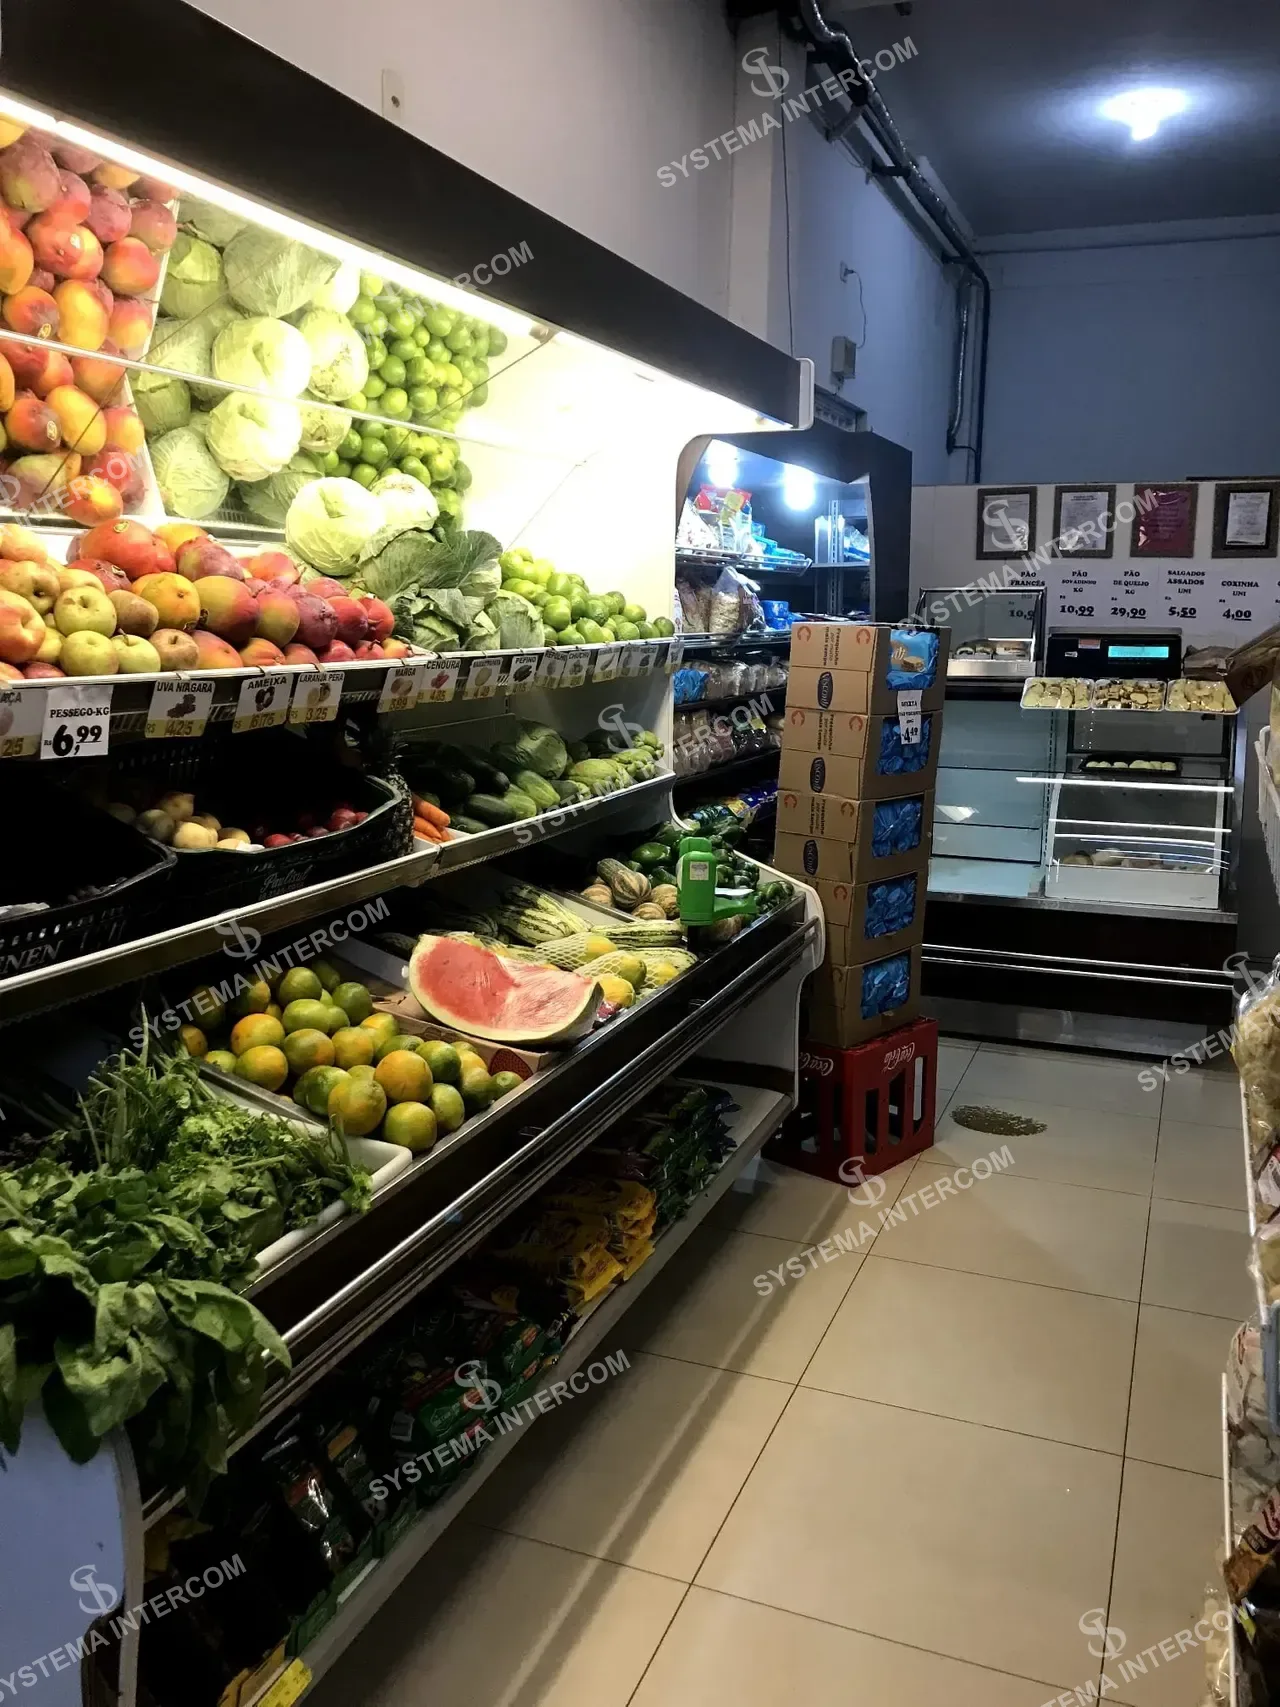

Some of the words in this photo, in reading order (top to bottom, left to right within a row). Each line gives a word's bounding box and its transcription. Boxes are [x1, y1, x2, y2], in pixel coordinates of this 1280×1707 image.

[1020, 570, 1037, 578] PÃO
[1072, 570, 1088, 578] PÃO
[1124, 570, 1140, 578] PÃO
[1167, 570, 1206, 578] SALGADOS
[1166, 578, 1205, 586] ASSADOS
[1221, 580, 1260, 588] COXINHA
[1009, 609, 1036, 621] 10,9
[1060, 605, 1095, 617] 10,99
[1110, 607, 1147, 619] 29,90
[1168, 606, 1197, 618] 5,50
[1222, 608, 1252, 622] 4,00
[515, 656, 536, 664] PEPINO
[247, 676, 287, 690] AMEIXA
[299, 673, 327, 682] LARANJA
[328, 673, 344, 682] PERA
[157, 682, 174, 692] UVA
[175, 682, 212, 693] NIAGARA
[50, 707, 110, 718] PESSEGO-KG
[52, 724, 102, 757] 6,99
[799, 1052, 834, 1077] Coca-Co
